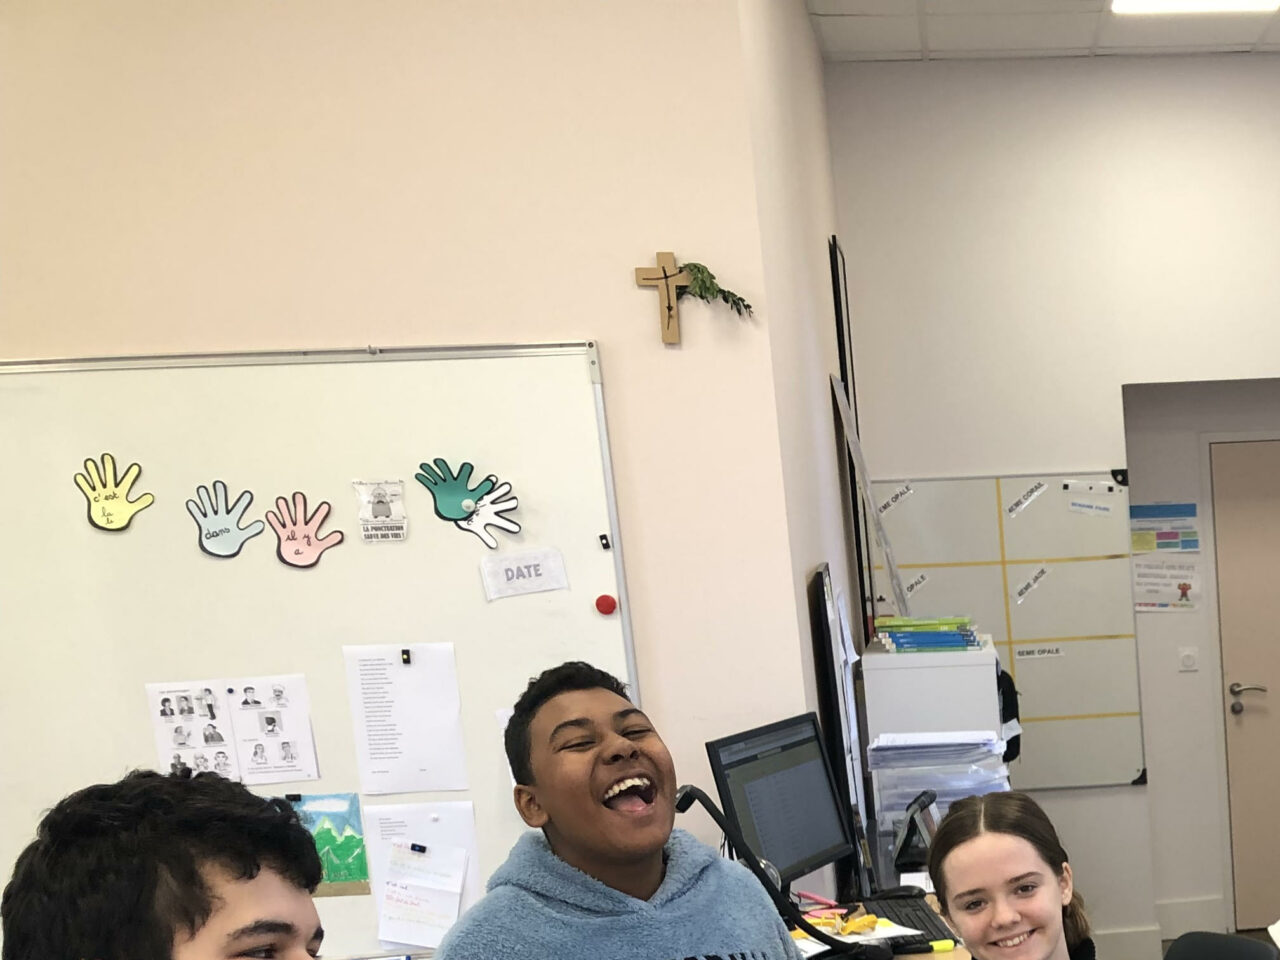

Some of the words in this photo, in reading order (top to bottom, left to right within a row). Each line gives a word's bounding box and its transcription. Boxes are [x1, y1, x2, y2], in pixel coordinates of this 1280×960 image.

[93, 491, 120, 504] c'est
[890, 484, 911, 503] OPALE
[204, 526, 231, 540] dans
[285, 530, 299, 542] il
[302, 534, 313, 547] y
[294, 548, 304, 556] a
[504, 563, 543, 582] DATE
[906, 573, 927, 593] OPALE
[1037, 647, 1060, 656] OPALE
